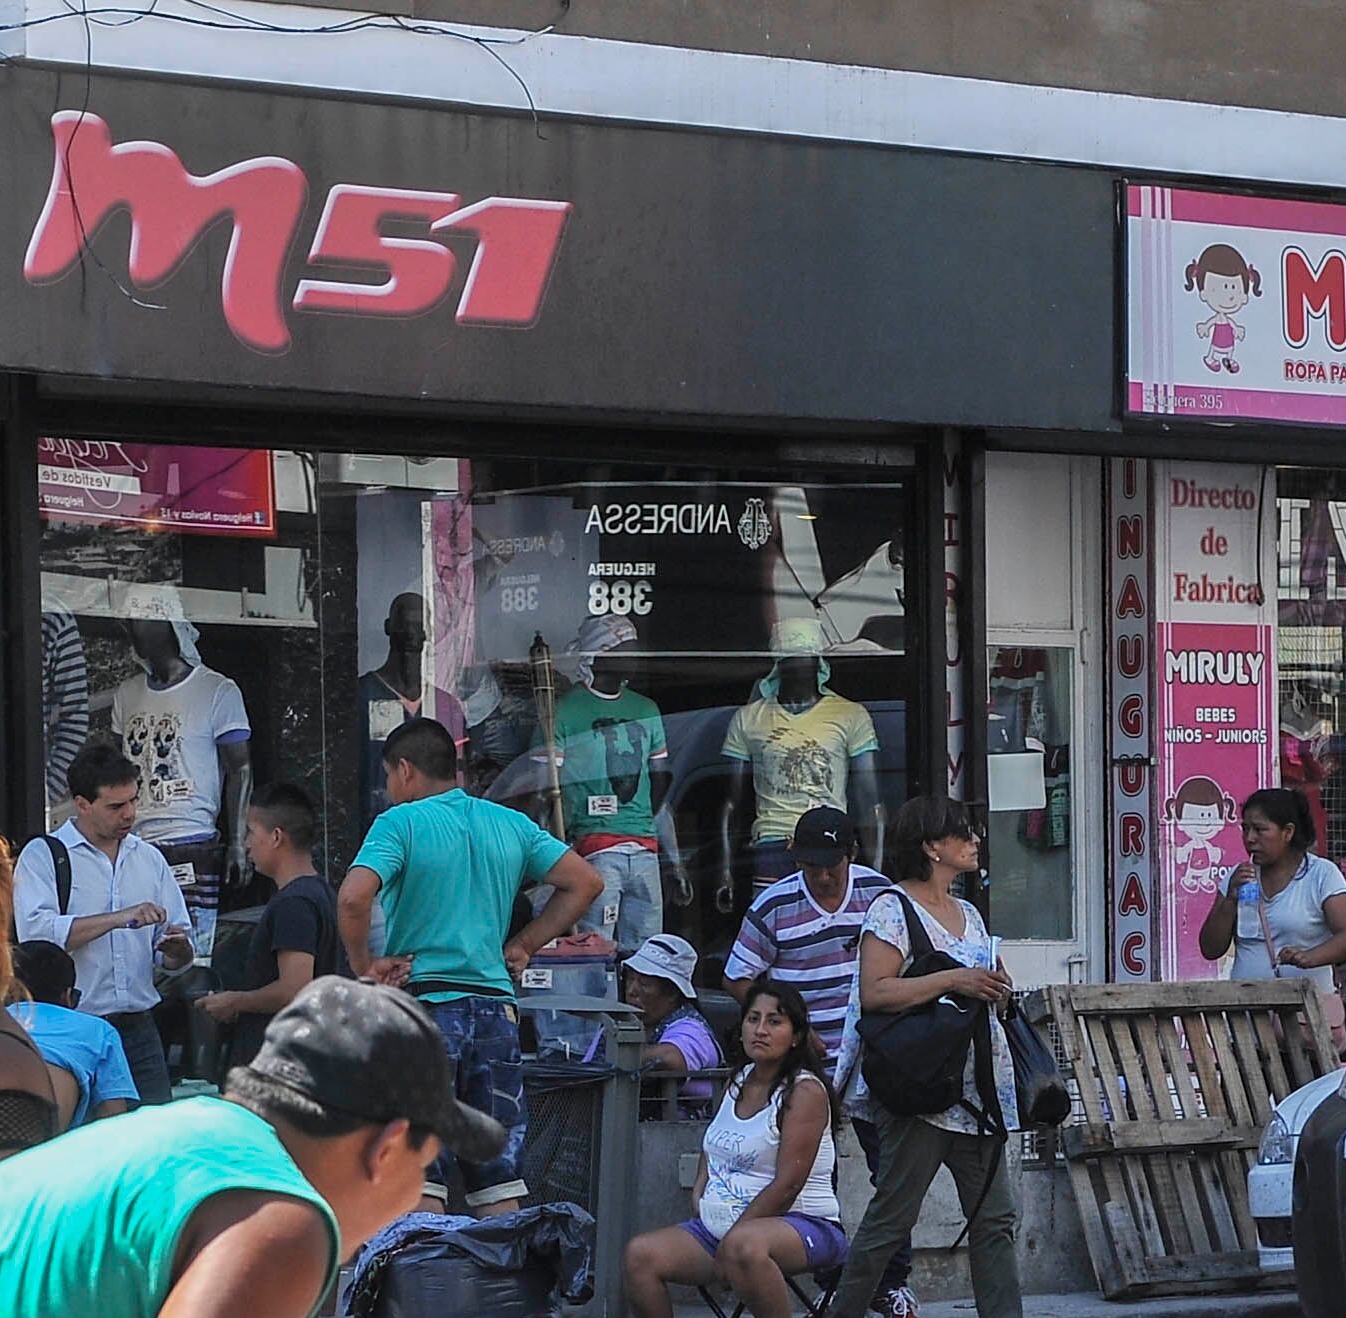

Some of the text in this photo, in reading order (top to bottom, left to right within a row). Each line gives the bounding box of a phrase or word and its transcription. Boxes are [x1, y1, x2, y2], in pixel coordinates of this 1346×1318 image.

[1284, 360, 1324, 381] ROPA
[1199, 393, 1224, 409] 395
[1171, 479, 1256, 510] Directo
[1200, 526, 1228, 556] de
[1173, 572, 1259, 604] Fabrica
[1165, 650, 1264, 685] MIRULY
[1195, 707, 1236, 723] BEBES
[1164, 726, 1202, 743] NIÑOS
[1215, 729, 1267, 744] JUNIORS
